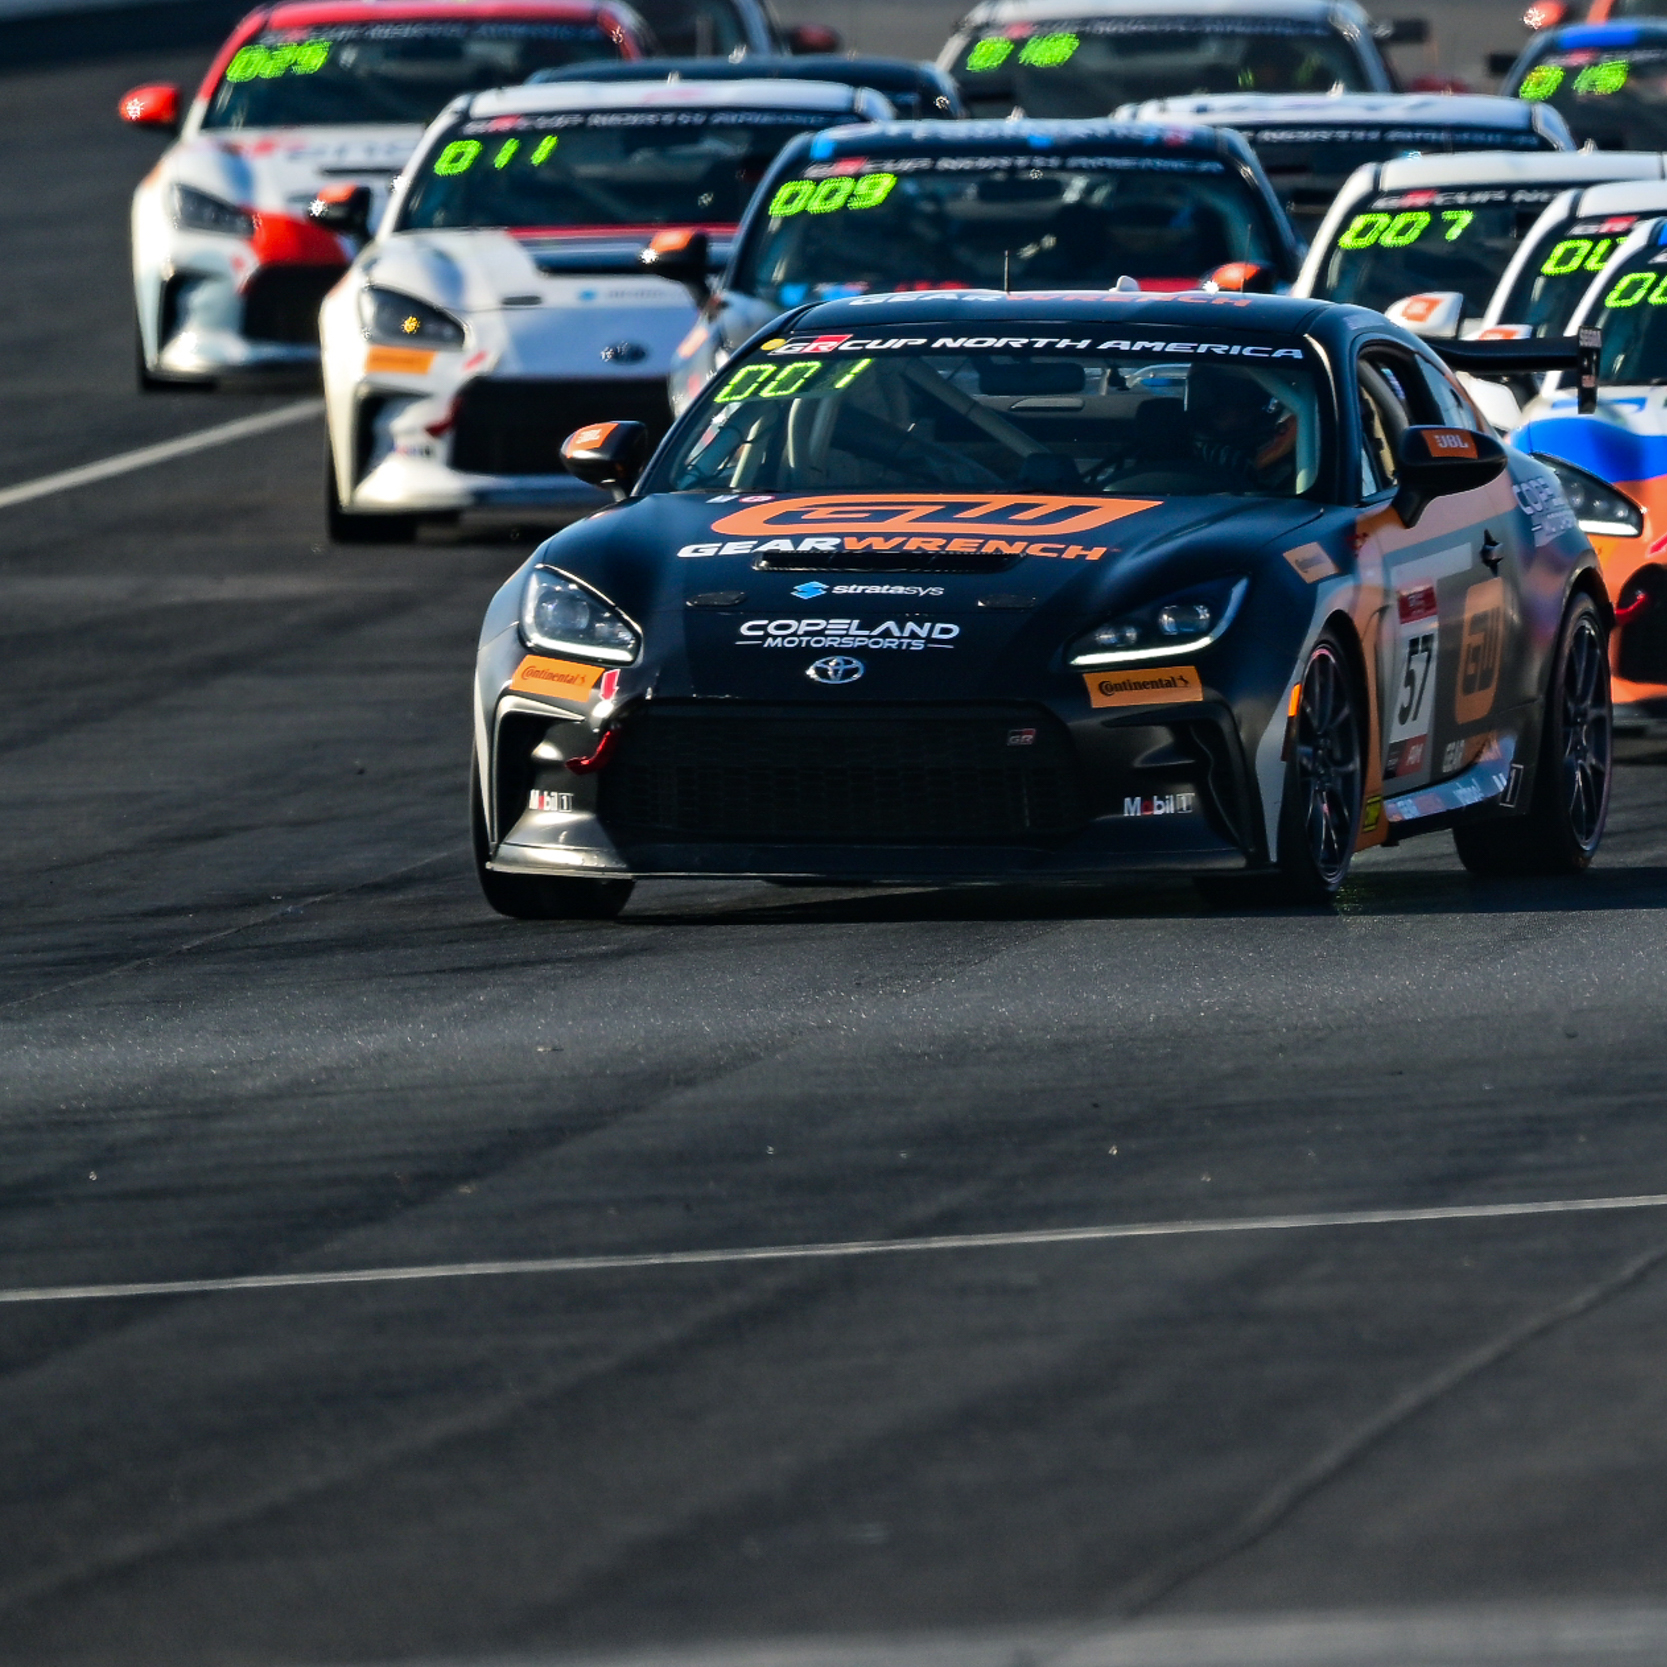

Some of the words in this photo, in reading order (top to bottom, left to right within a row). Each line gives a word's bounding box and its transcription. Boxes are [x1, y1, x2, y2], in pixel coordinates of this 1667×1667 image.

[433, 135, 558, 176] 011
[768, 173, 897, 217] 009
[1338, 210, 1475, 249] 007
[847, 291, 1252, 308] GEARWRENCH
[837, 337, 921, 352] CUP
[929, 337, 1090, 351] NORTH
[1097, 339, 1305, 360] AMERICA
[713, 357, 872, 404] 001
[1435, 434, 1470, 449] JBL
[677, 536, 1109, 561] GEARWRENCH
[831, 582, 945, 598] stratasys
[738, 618, 961, 641] COPELAND
[763, 636, 927, 651] MOTORSPORTS
[520, 665, 579, 685] Continental
[1097, 675, 1179, 696] Continental
[1398, 633, 1435, 725] 57
[1124, 794, 1175, 817] Mobil
